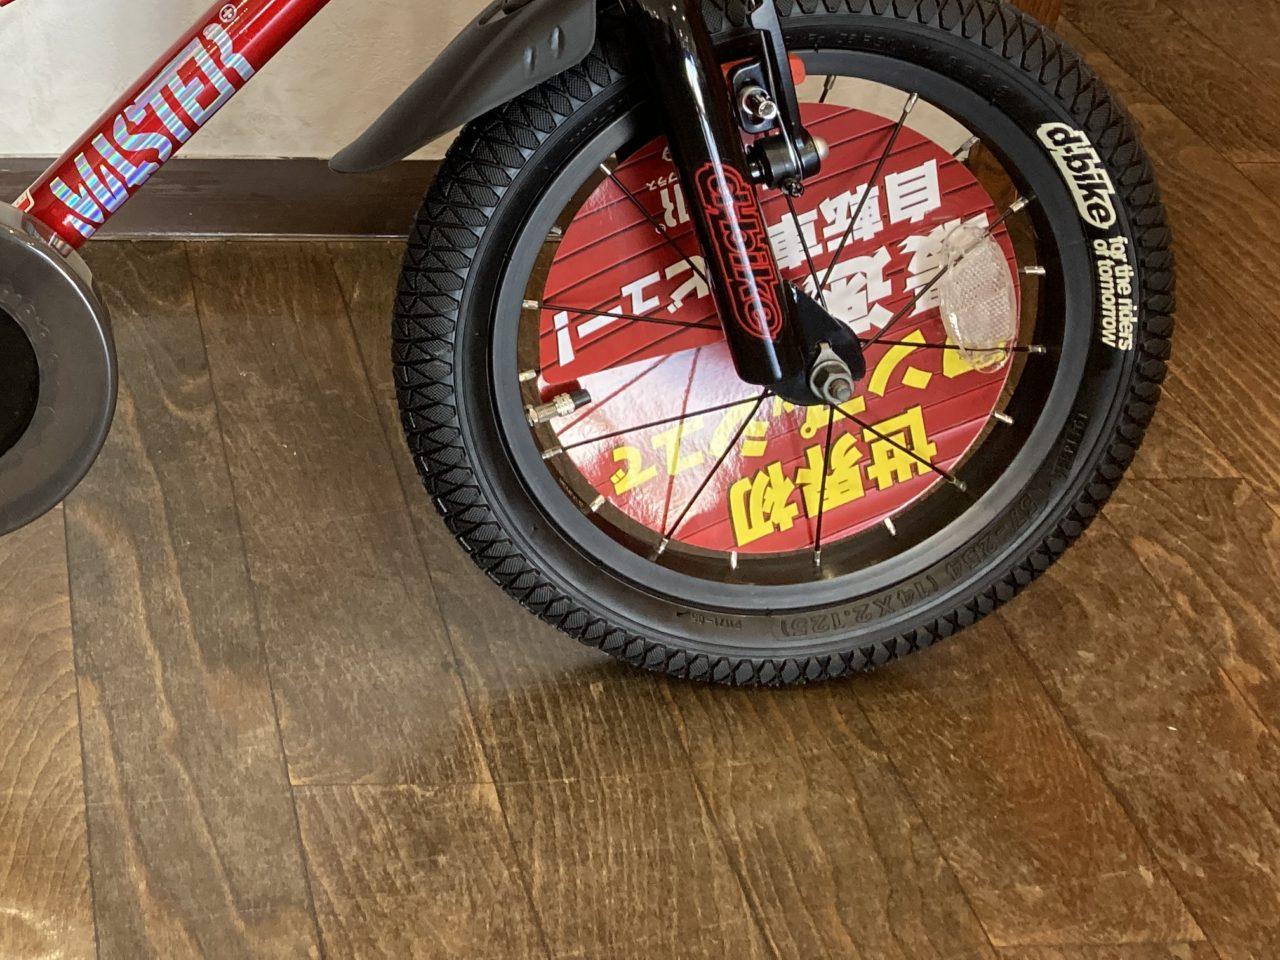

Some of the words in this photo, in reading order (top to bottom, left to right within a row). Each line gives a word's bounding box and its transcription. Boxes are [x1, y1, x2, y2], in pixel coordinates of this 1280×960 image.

[50, 23, 255, 239] MASTER
[1093, 239, 1112, 257] of
[1108, 236, 1129, 262] for
[1097, 259, 1117, 348] tomorrow
[1114, 263, 1135, 295] the
[1118, 298, 1139, 351] riders
[729, 404, 938, 547] 世界初
